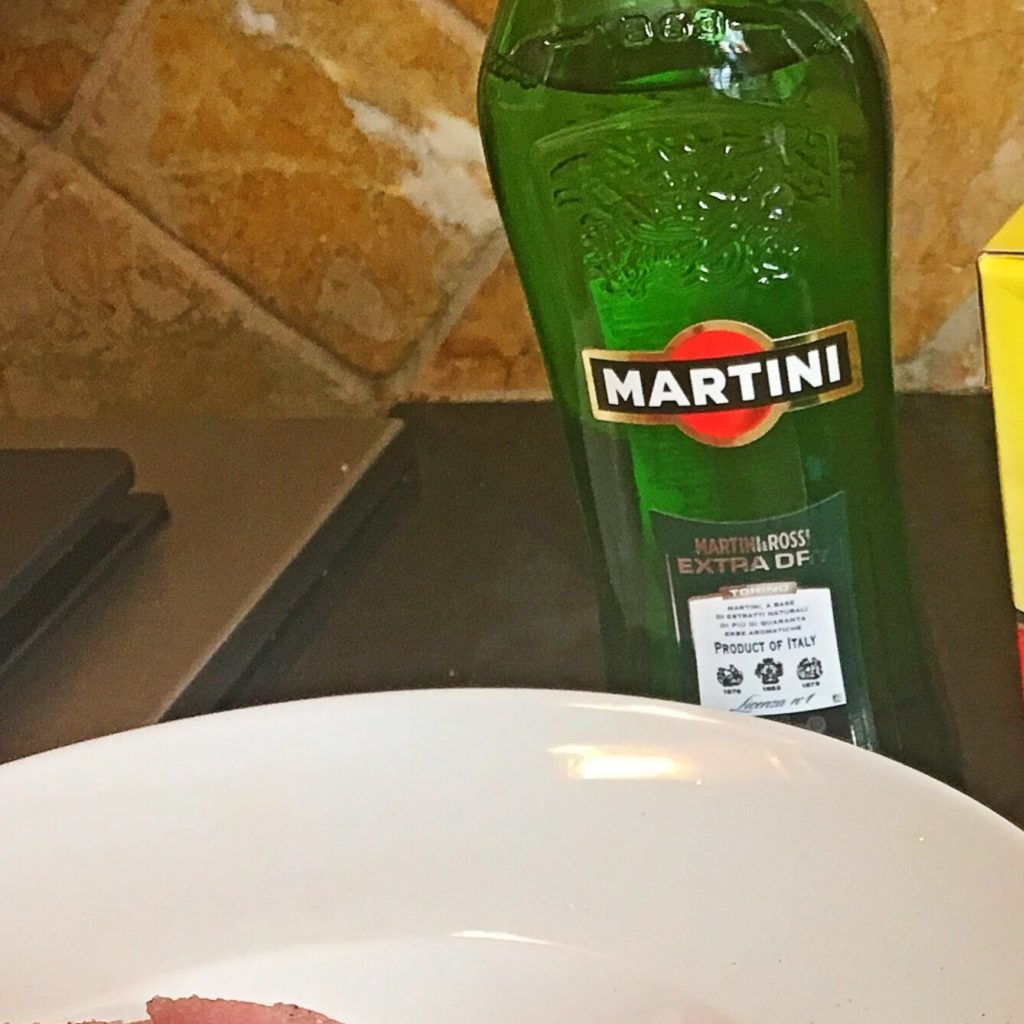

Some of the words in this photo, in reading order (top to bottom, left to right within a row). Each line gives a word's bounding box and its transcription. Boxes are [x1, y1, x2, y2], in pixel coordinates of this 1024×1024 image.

[602, 344, 841, 408] MARTINI
[677, 556, 769, 574] EXTRA
[774, 599, 795, 607] BASE
